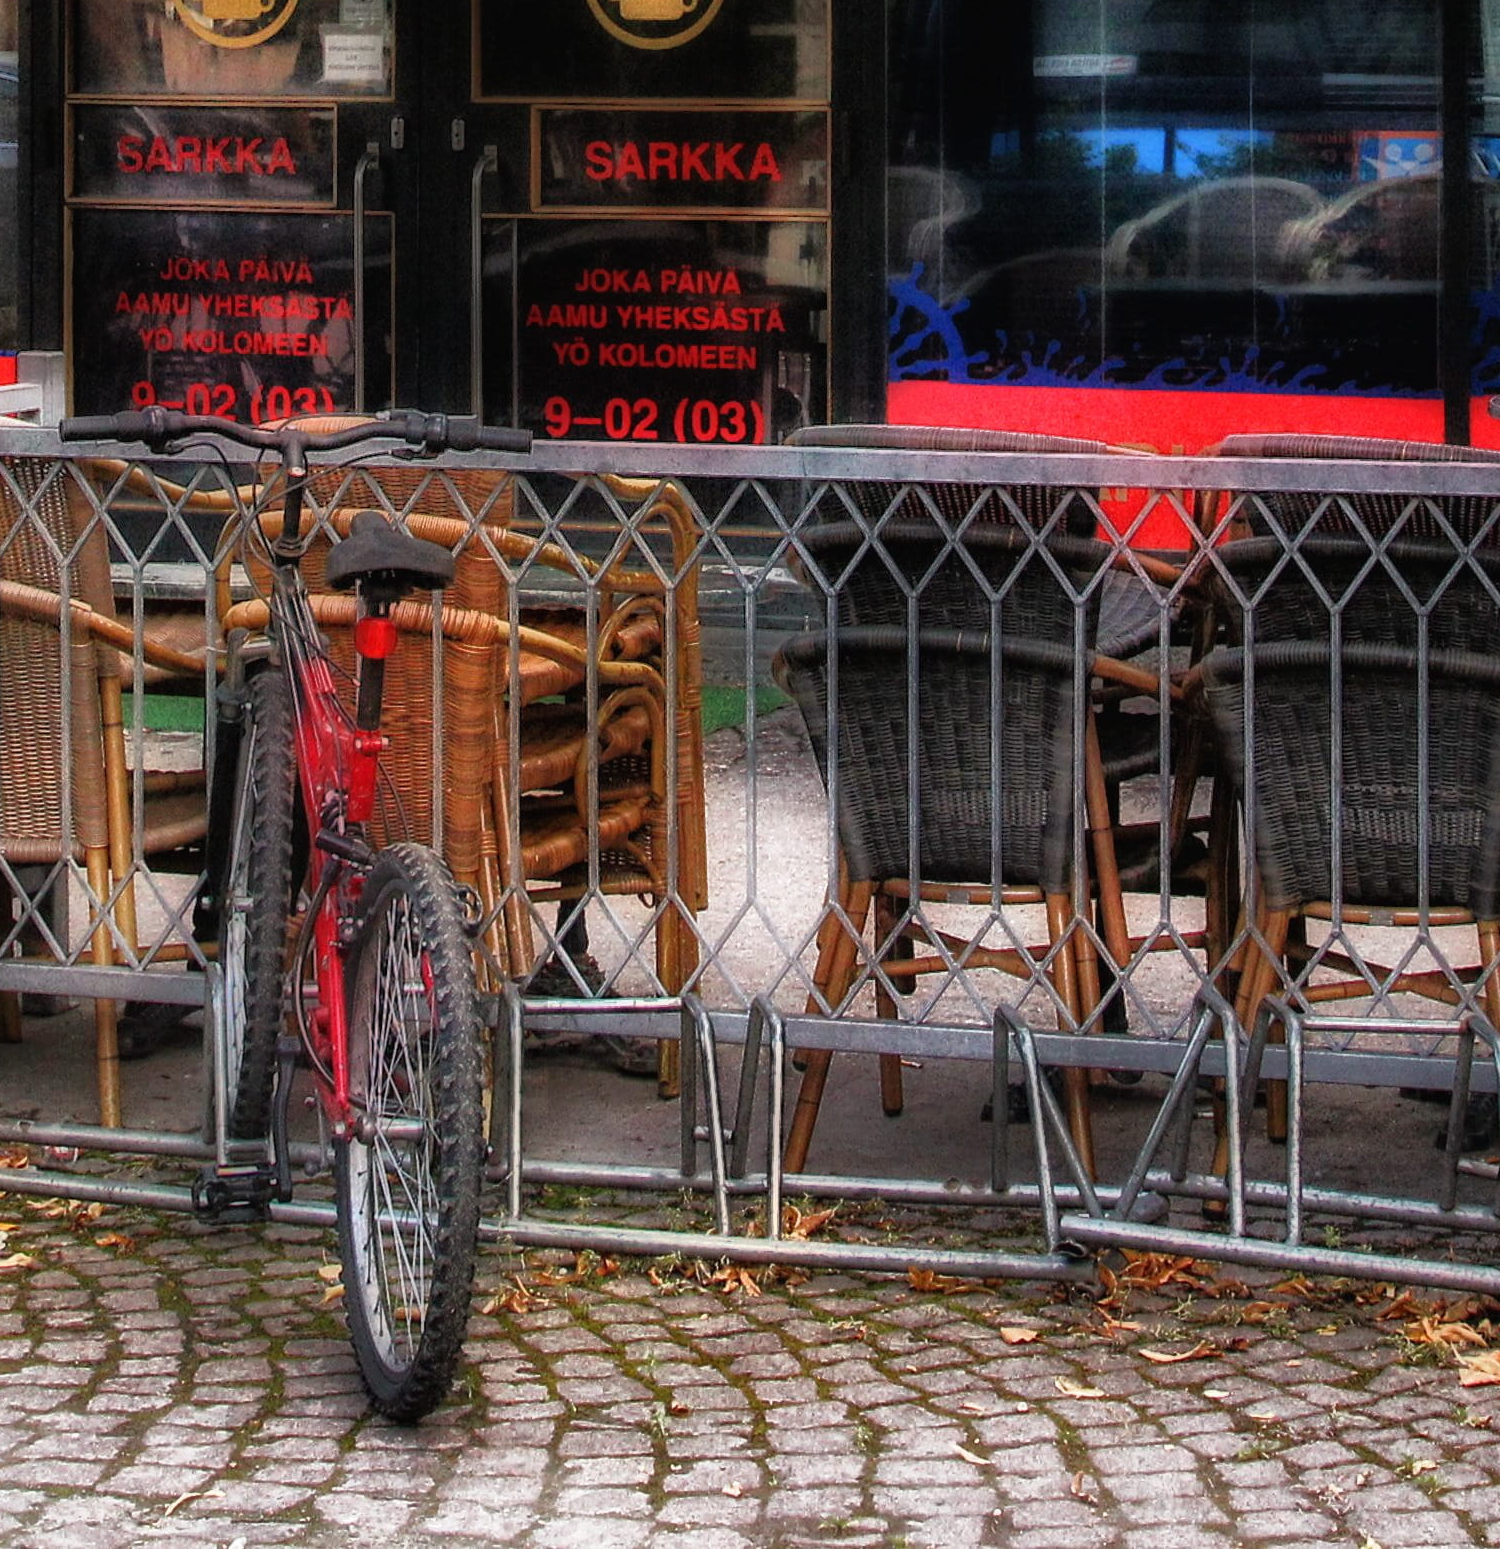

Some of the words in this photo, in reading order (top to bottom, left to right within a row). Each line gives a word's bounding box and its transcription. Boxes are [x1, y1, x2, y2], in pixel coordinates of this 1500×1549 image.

[116, 135, 296, 175] SARKKA
[585, 141, 782, 182] SARKKA
[160, 257, 231, 281] JOKA
[238, 255, 315, 284] PÄIVÄ
[575, 269, 651, 293] JOKA
[660, 265, 741, 295] PÄIVÄ
[115, 291, 190, 316] AAMU
[200, 290, 354, 320] YHEKSÄSTÄ
[526, 304, 607, 329] AAMU
[617, 302, 786, 332] YHEKSÄSTÄ
[138, 323, 174, 351] YÖ
[181, 330, 329, 357] KOLOMEEN
[552, 337, 590, 367] YÖ
[599, 343, 757, 370] KOLOMEEN
[674, 397, 765, 445] (03)
